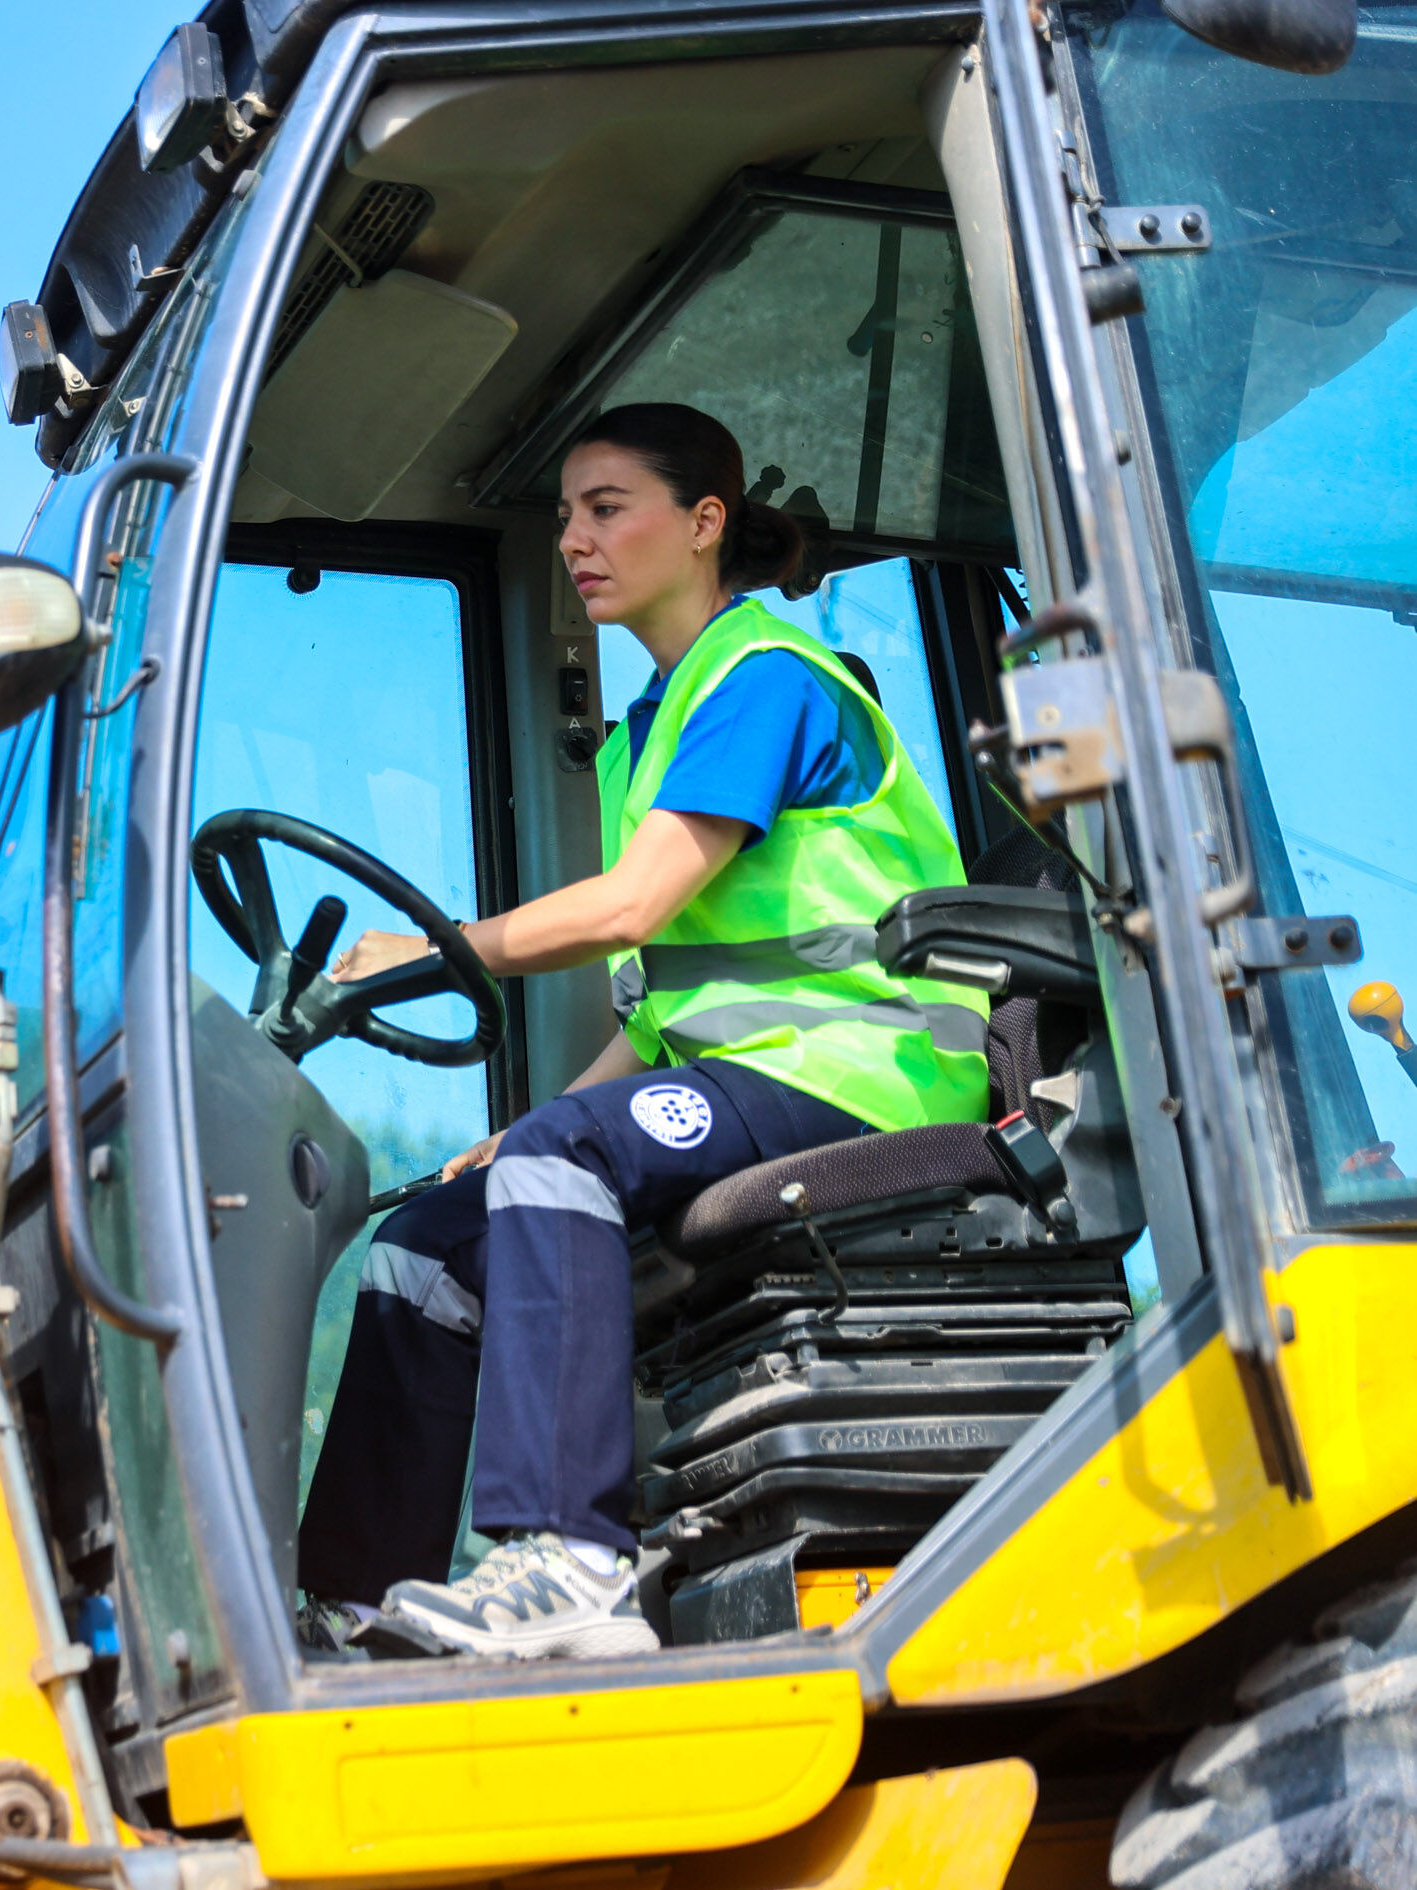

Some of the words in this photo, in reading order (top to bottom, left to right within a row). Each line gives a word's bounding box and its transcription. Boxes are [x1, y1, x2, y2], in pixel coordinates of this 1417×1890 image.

[567, 647, 580, 664] K
[568, 717, 581, 729] A
[847, 1424, 987, 1448] GRAMMER
